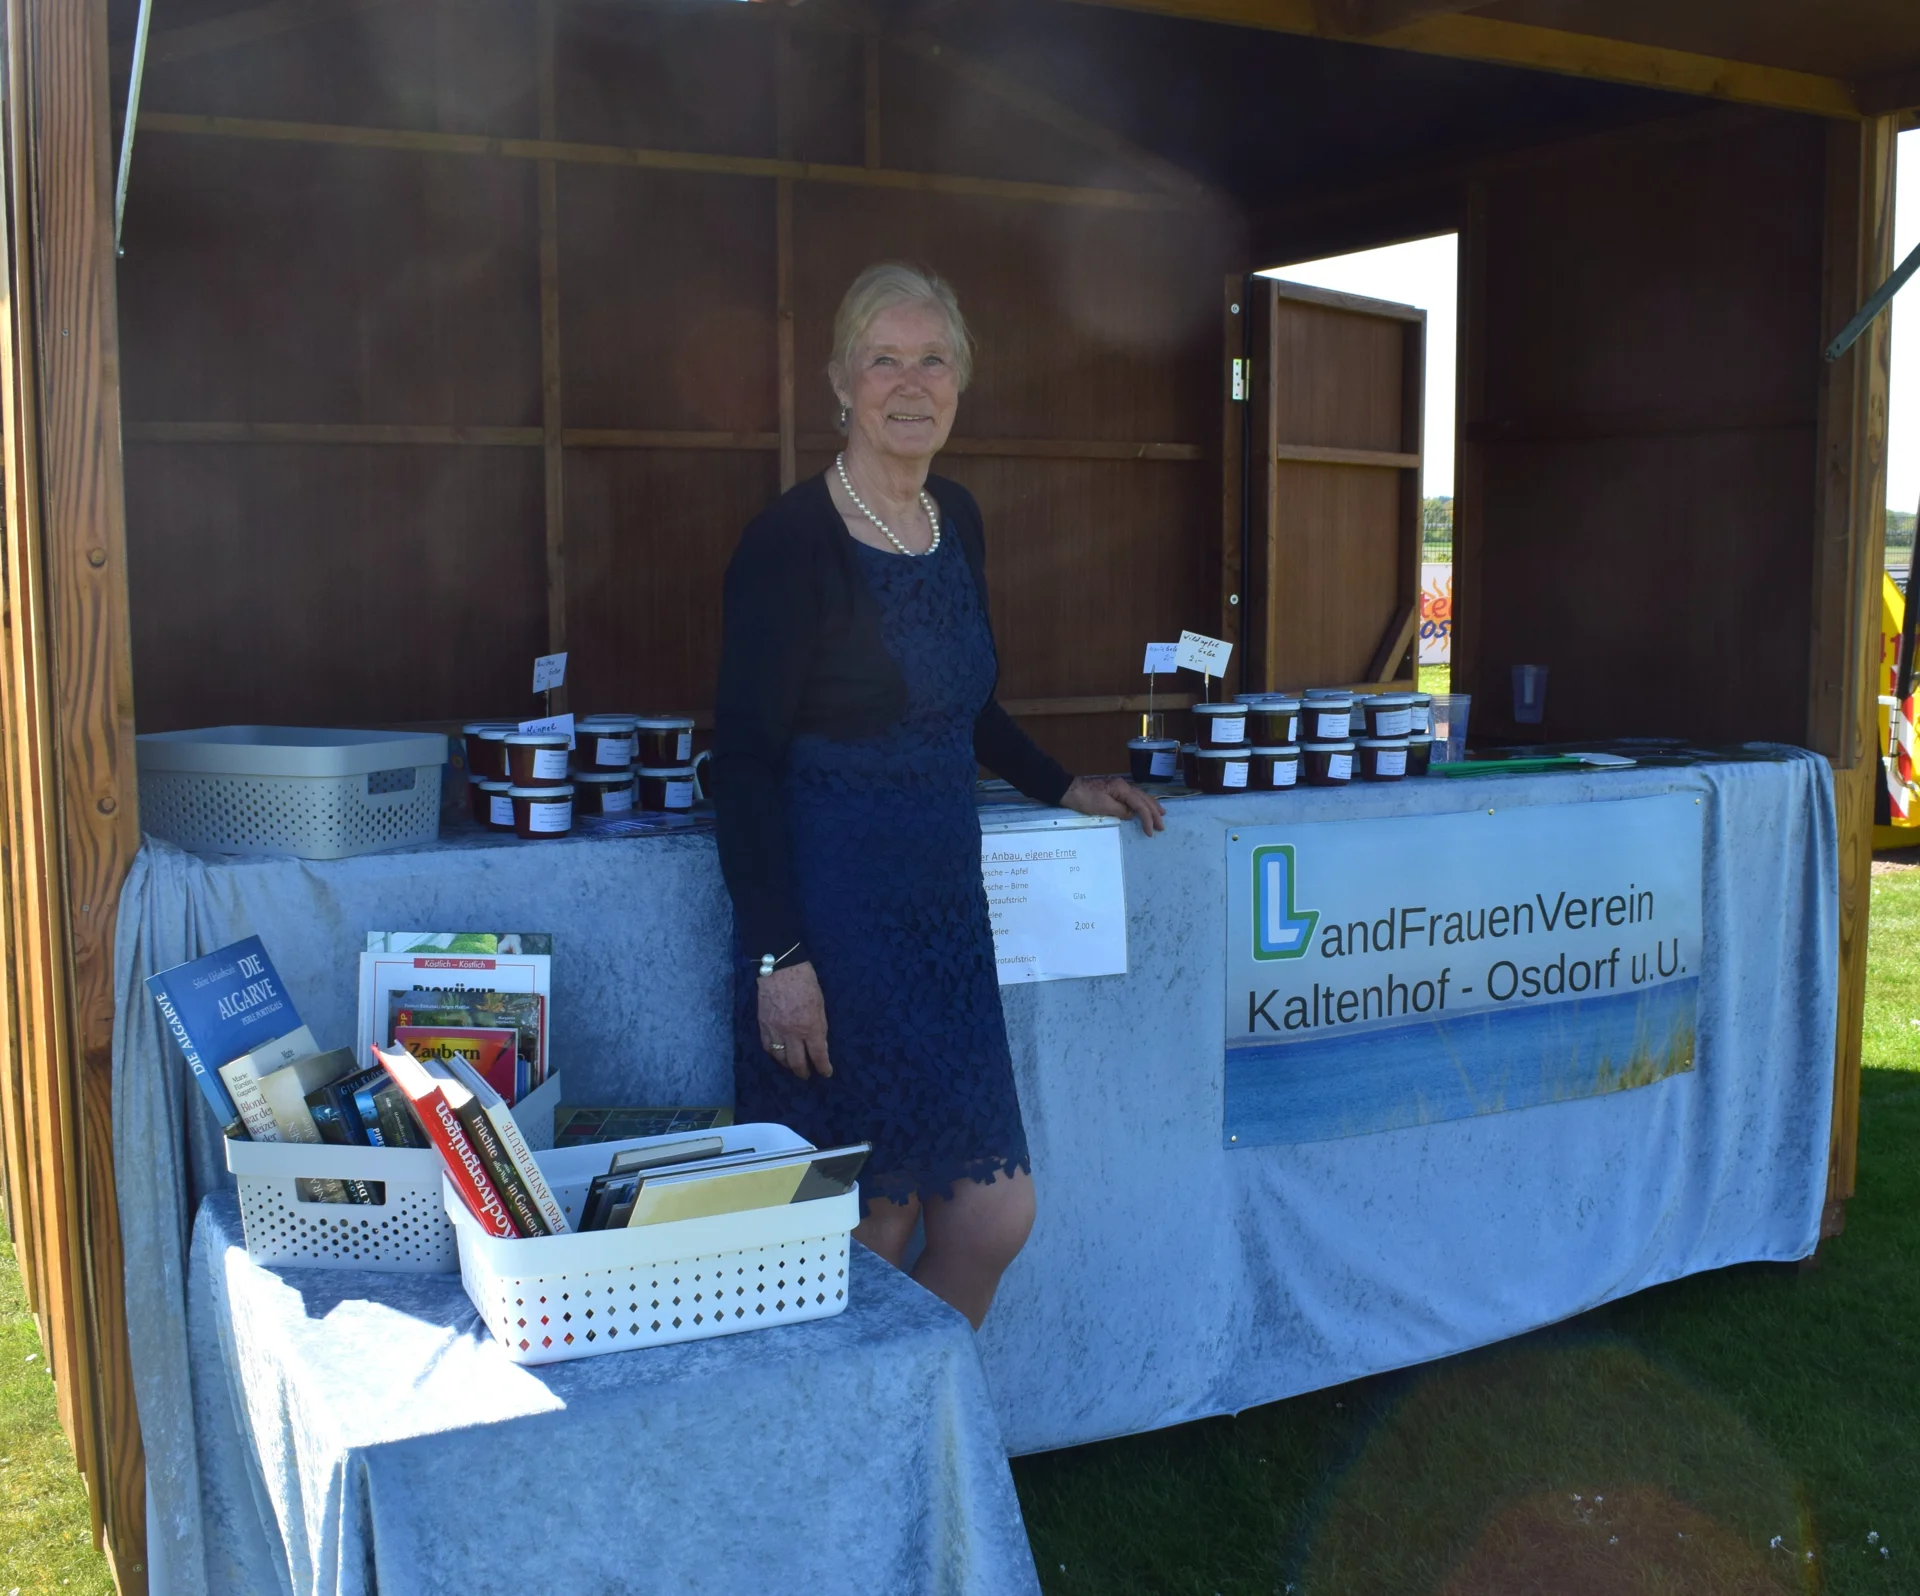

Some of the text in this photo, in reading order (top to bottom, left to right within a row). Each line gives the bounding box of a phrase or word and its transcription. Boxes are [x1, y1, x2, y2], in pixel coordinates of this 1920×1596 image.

[991, 851, 1023, 862] Anbau,
[1025, 850, 1054, 861] eigene
[1055, 849, 1077, 858] Ernte
[982, 868, 1004, 877] irsche
[1010, 867, 1029, 876] Apfel
[1010, 881, 1029, 890] Birne
[1073, 892, 1087, 900] Glas
[986, 896, 1027, 905] rotaufstrich
[1251, 842, 1654, 964] LandFrauenVerein
[237, 953, 265, 979] DIE
[424, 959, 451, 969] Köstlich
[458, 960, 486, 970] Köstlich
[217, 977, 277, 1020] ALGARVE
[1248, 967, 1451, 1034] Kaltenhof
[1486, 947, 1621, 1003] Osdorf
[1630, 937, 1687, 986] u.U.
[155, 991, 206, 1076] DIE ALGARVE
[231, 1072, 249, 1084] Marie
[240, 1093, 267, 1113] Blond
[472, 1114, 499, 1159] Früchte
[435, 1100, 520, 1239] Kochvergnügen
[501, 1121, 565, 1233] FRAU ANTJE HEUTE
[508, 1181, 518, 1195] in
[514, 1191, 538, 1232] Garten
